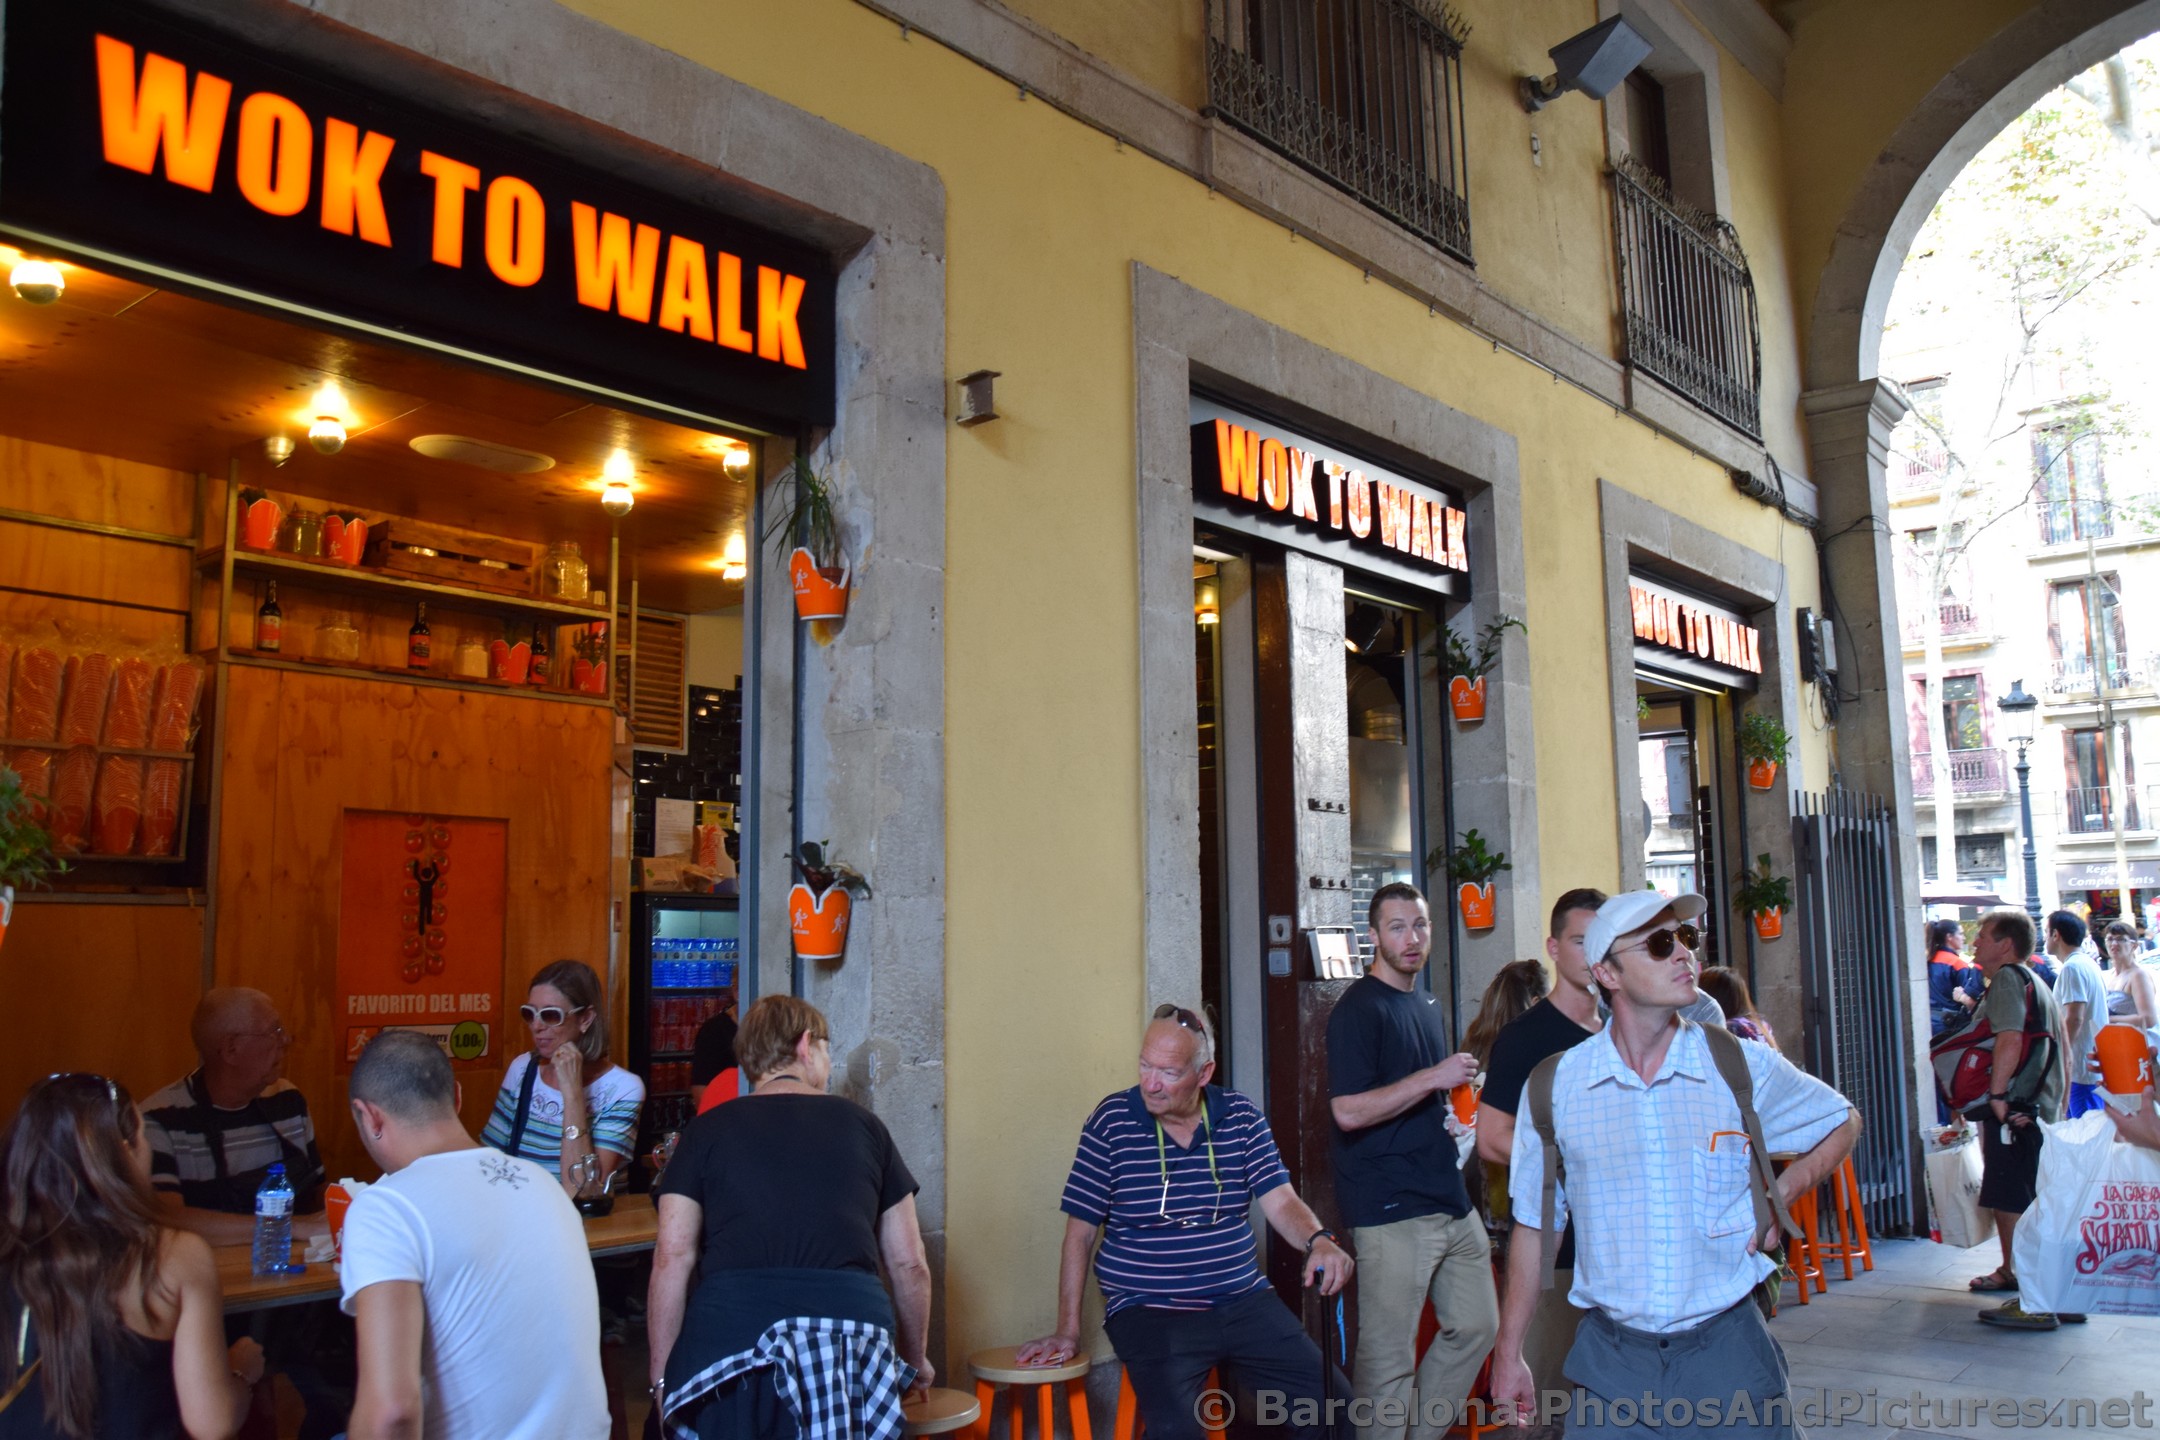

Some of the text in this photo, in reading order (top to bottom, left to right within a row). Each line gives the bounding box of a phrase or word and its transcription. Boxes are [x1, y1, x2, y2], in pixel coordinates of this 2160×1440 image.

[95, 33, 807, 370] WOK TO WALK
[1215, 417, 1468, 573] WOK TO WALK
[1629, 584, 1762, 674] WOK TO WALK
[2067, 875, 2155, 888] Compleents
[348, 993, 491, 1015] FAVORITO DEL MES
[2102, 1184, 2123, 1202] LA
[2111, 1203, 2160, 1221] DE LES
